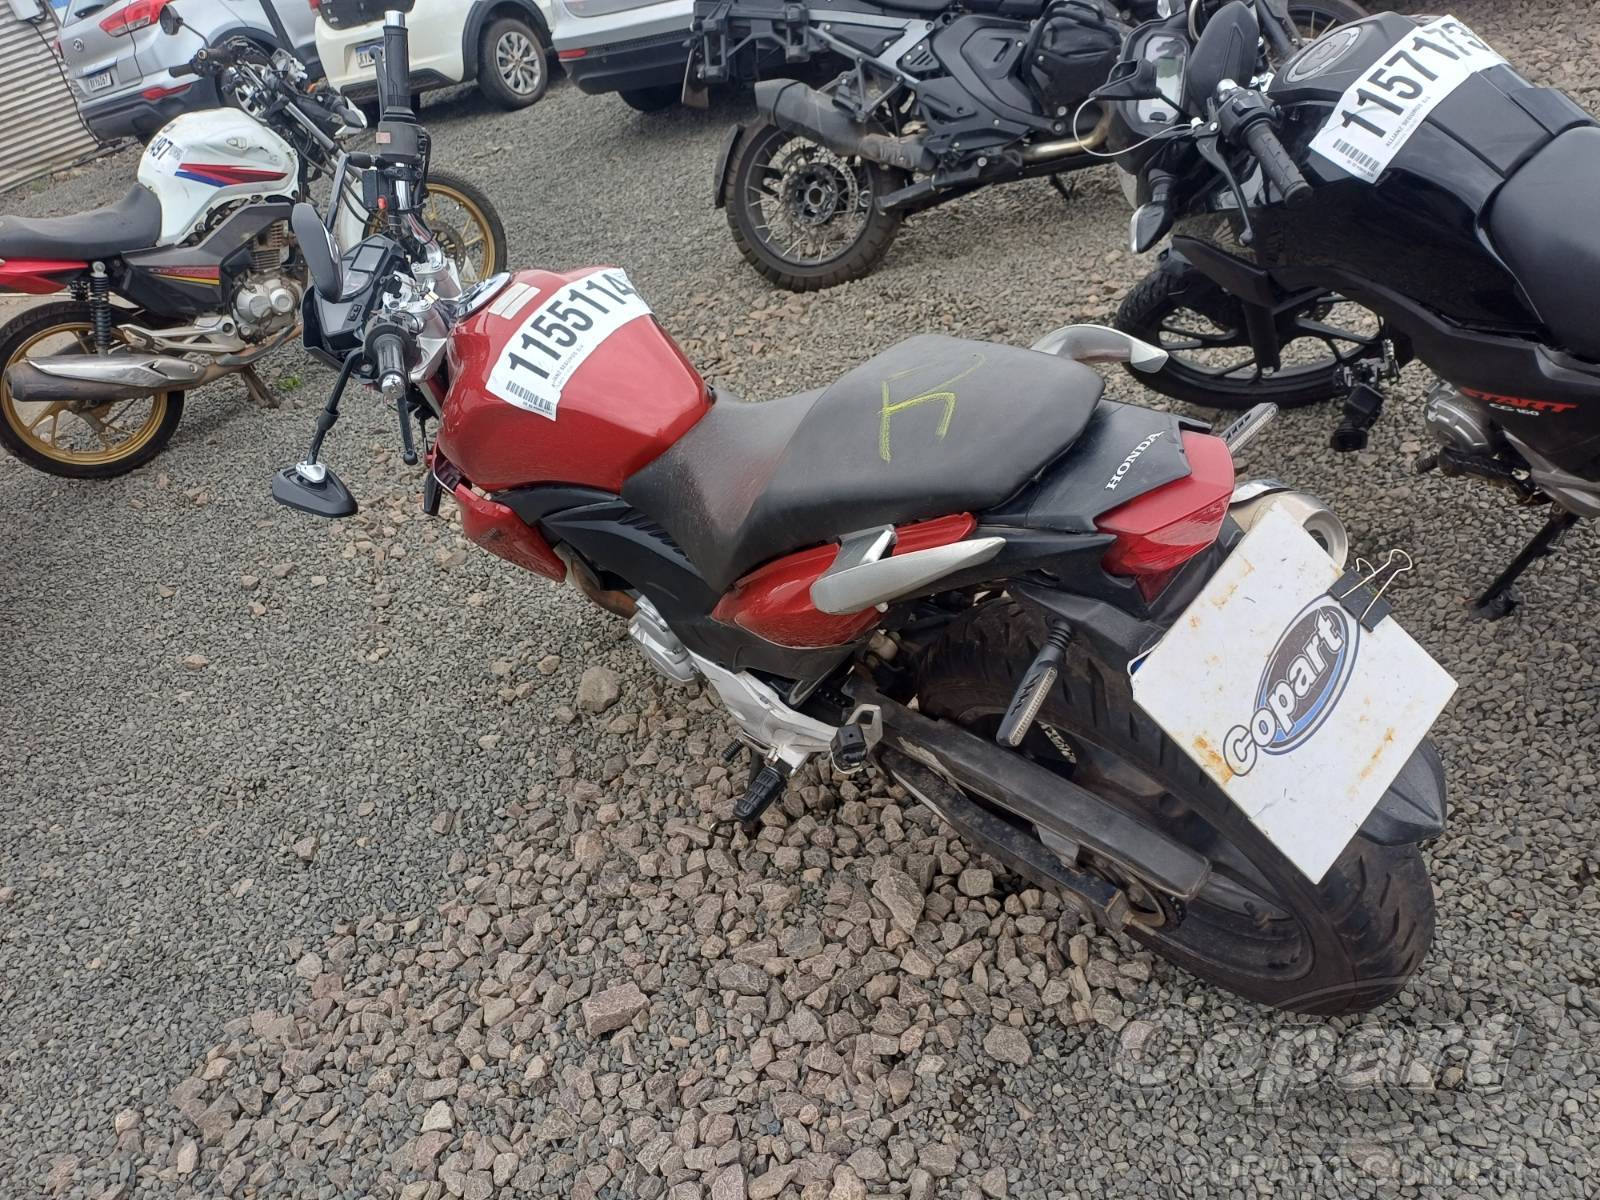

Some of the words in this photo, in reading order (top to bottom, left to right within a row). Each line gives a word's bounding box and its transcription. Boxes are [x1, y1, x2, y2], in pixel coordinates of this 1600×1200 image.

[1341, 22, 1491, 138] 1157173
[508, 272, 635, 380] 1155114
[1105, 430, 1166, 491] HONDA
[1223, 605, 1348, 778] Copart
